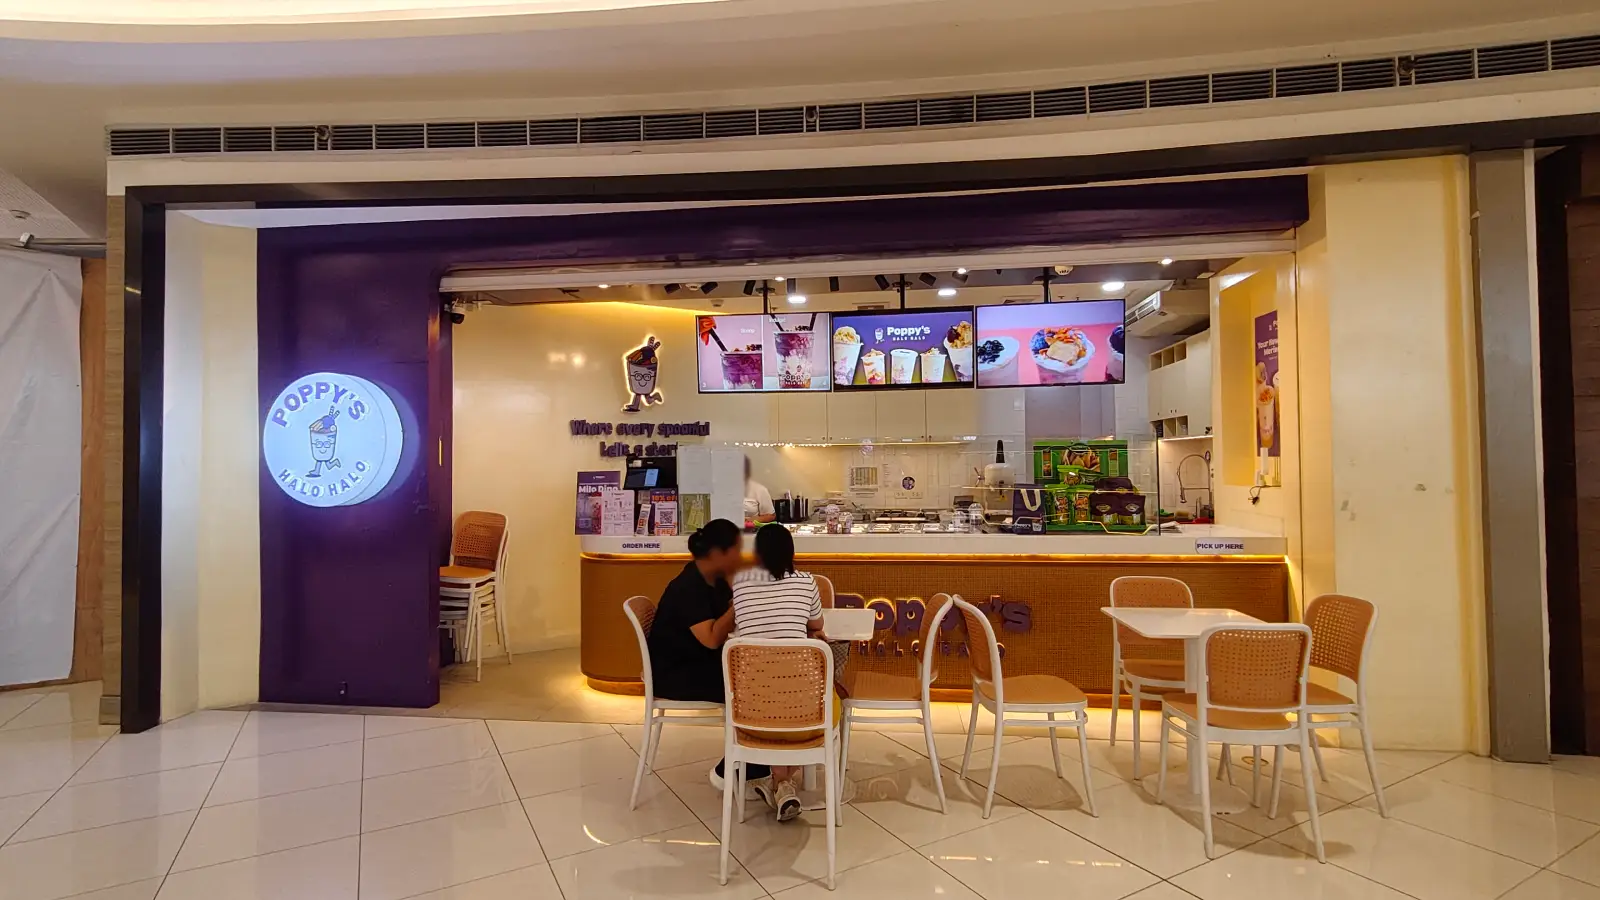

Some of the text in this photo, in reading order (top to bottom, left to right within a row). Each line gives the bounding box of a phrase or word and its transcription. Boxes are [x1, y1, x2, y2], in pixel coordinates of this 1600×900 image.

[887, 325, 931, 337] Poppy's
[272, 381, 366, 428] POPPY'S
[569, 419, 710, 438] Where every spoonful
[599, 441, 630, 457] tells
[634, 445, 643, 457] a
[278, 460, 367, 498] HALO HALO
[578, 484, 619, 493] Milo Dino
[655, 528, 676, 536] FREE
